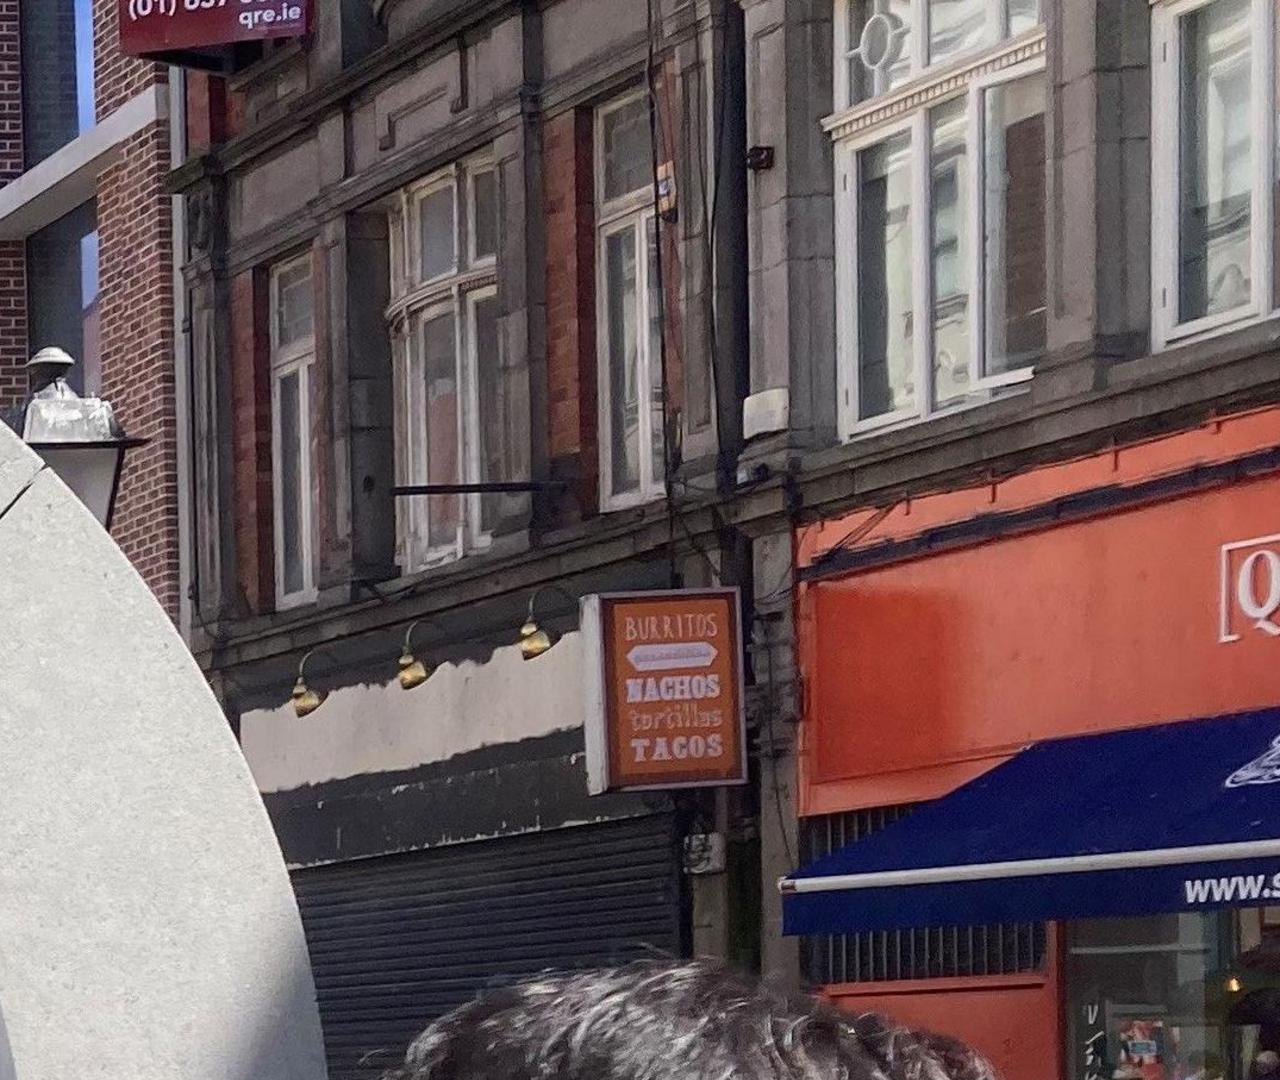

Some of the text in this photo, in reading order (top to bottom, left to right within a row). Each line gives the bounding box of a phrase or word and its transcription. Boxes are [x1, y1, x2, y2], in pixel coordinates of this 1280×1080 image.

[238, 3, 302, 29] qre.ie
[625, 613, 718, 641] BURRITOS
[626, 674, 721, 703] NACHOS
[631, 733, 724, 762] TACOS
